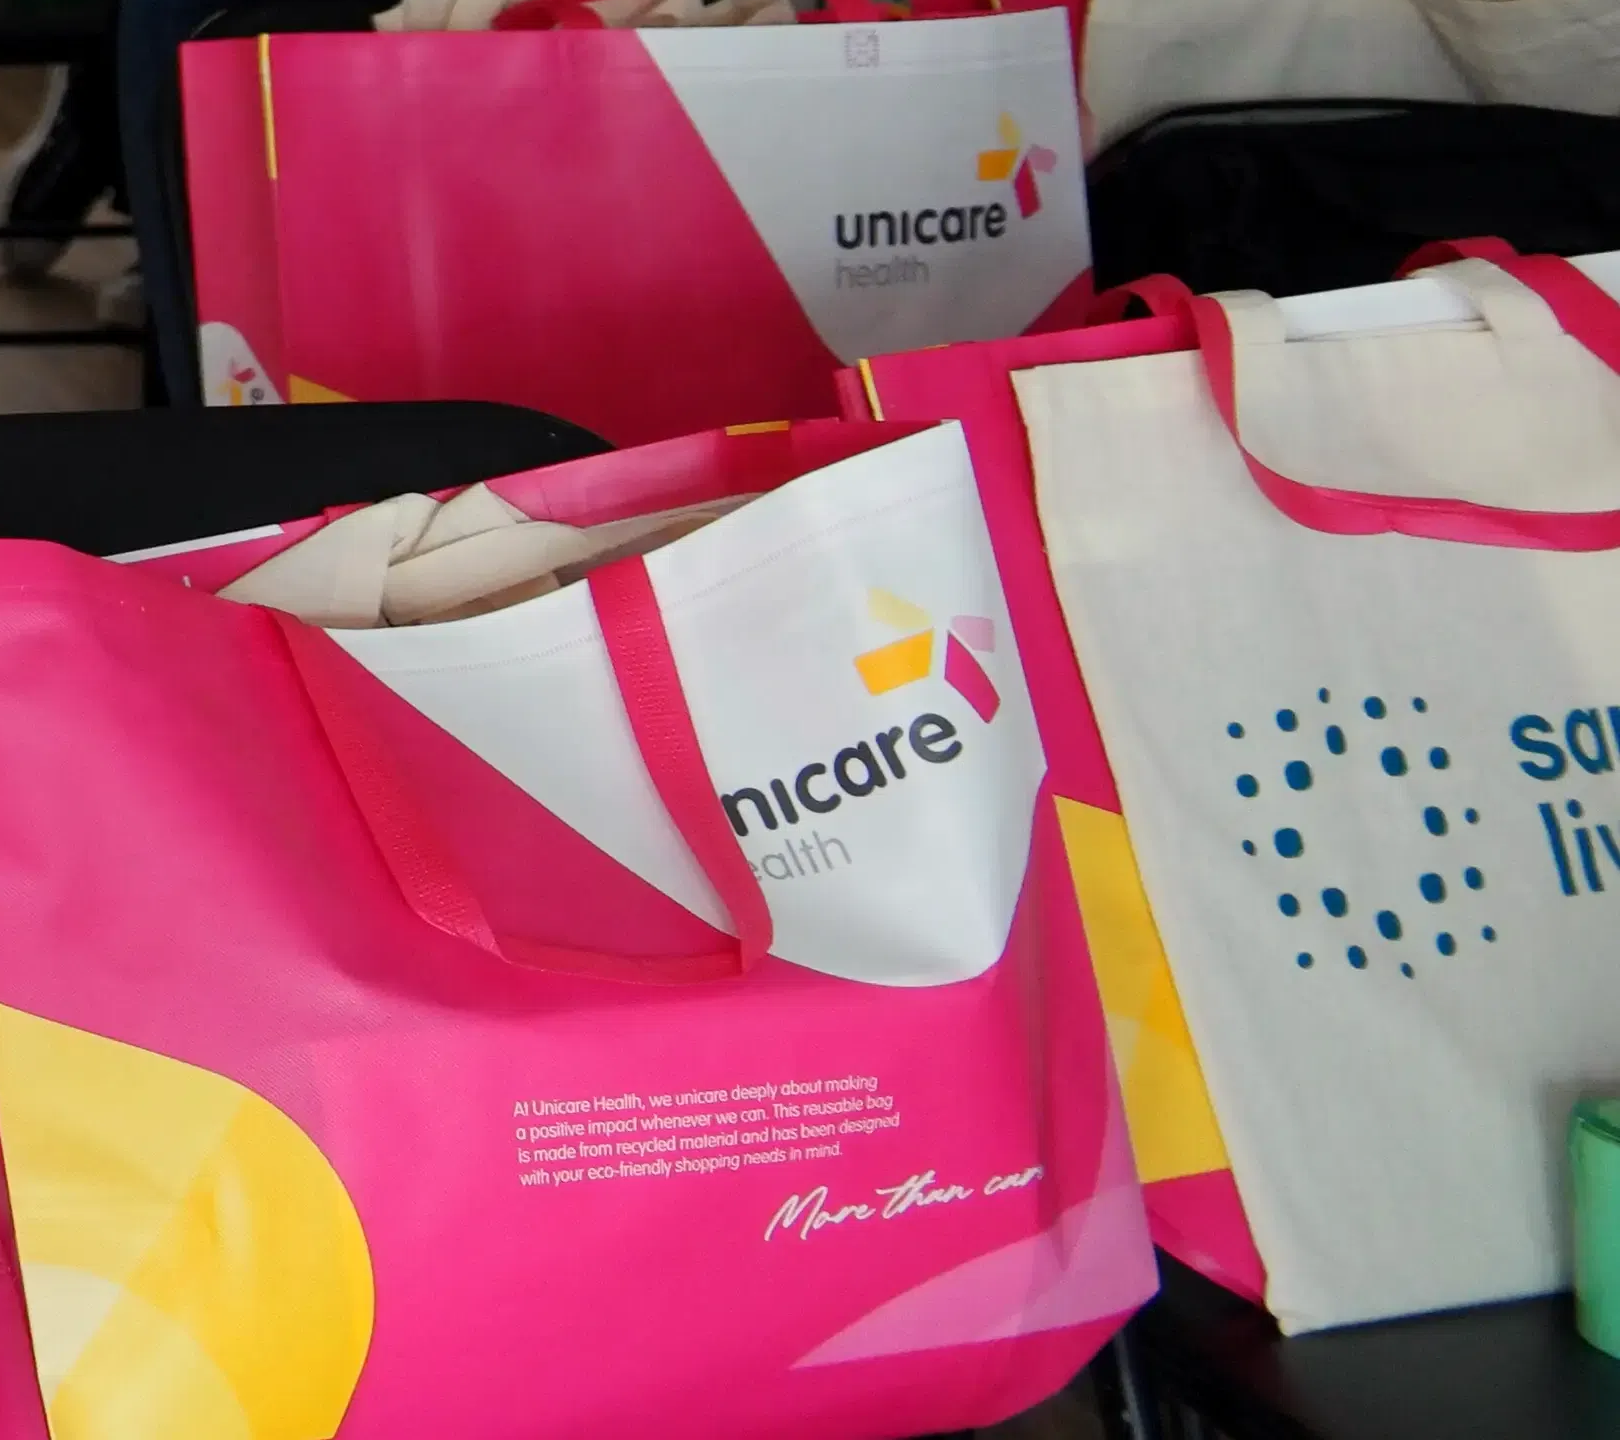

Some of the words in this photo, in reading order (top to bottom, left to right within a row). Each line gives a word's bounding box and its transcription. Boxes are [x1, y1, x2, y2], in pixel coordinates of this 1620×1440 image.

[834, 201, 1008, 250] unicare
[834, 255, 931, 290] health
[720, 712, 963, 837] nicare
[515, 1126, 527, 1141] a
[529, 1121, 585, 1144] positive
[588, 1118, 638, 1138] impact
[640, 1112, 712, 1133] whenever
[715, 1111, 738, 1126] we
[740, 1106, 770, 1123] can.
[771, 1102, 801, 1120] This
[803, 1097, 864, 1117] reusable
[866, 1094, 894, 1112] bag
[532, 1097, 591, 1117] Unicare
[593, 1092, 646, 1112] Health,
[648, 1093, 673, 1109] we
[675, 1087, 729, 1107] unicare
[731, 1081, 778, 1104] deeply
[780, 1079, 823, 1097] about
[825, 1074, 879, 1094] making
[517, 1148, 530, 1164] is
[534, 1143, 577, 1162] made
[579, 1140, 613, 1159] from
[616, 1134, 677, 1157] recycled
[679, 1130, 738, 1151] material
[741, 1126, 769, 1145] and
[772, 1124, 798, 1142] has
[800, 1121, 836, 1139] been
[839, 1111, 900, 1135] designed
[519, 1167, 550, 1187] with
[553, 1168, 584, 1187] your
[587, 1157, 672, 1181] eco-friendly
[674, 1151, 740, 1175] shopping
[742, 1147, 787, 1166] needs
[789, 1144, 803, 1162] in
[805, 1140, 843, 1160] mind.
[763, 1185, 877, 1242] More
[874, 1169, 974, 1220] than
[983, 1164, 1044, 1196] car
